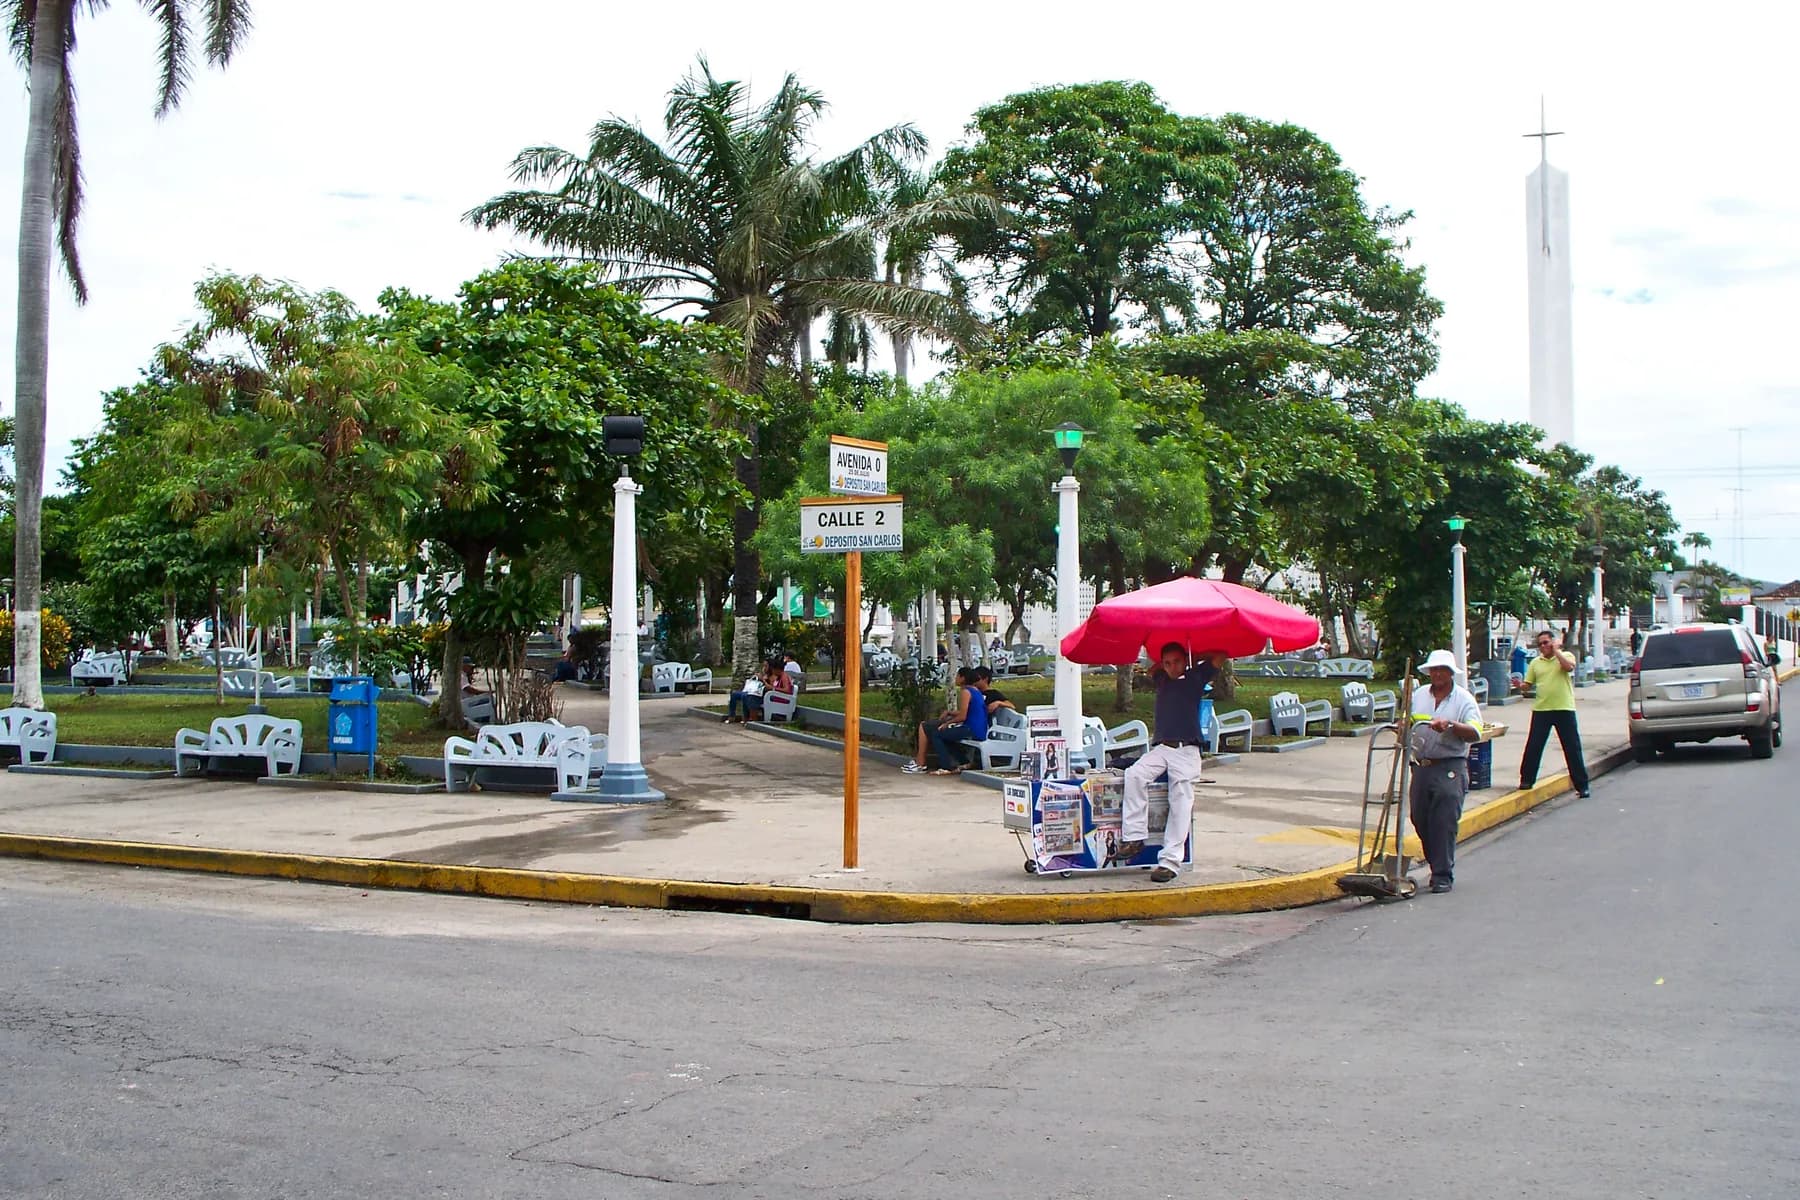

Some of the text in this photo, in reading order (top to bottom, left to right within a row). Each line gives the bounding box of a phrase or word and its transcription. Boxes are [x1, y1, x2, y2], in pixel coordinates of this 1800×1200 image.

[837, 451, 872, 471] AVENIDA
[844, 477, 886, 493] DEPOSITO SAN CARLOS
[818, 510, 885, 527] CALLE 2
[825, 534, 901, 548] DEPOSITO SAN CARLOS
